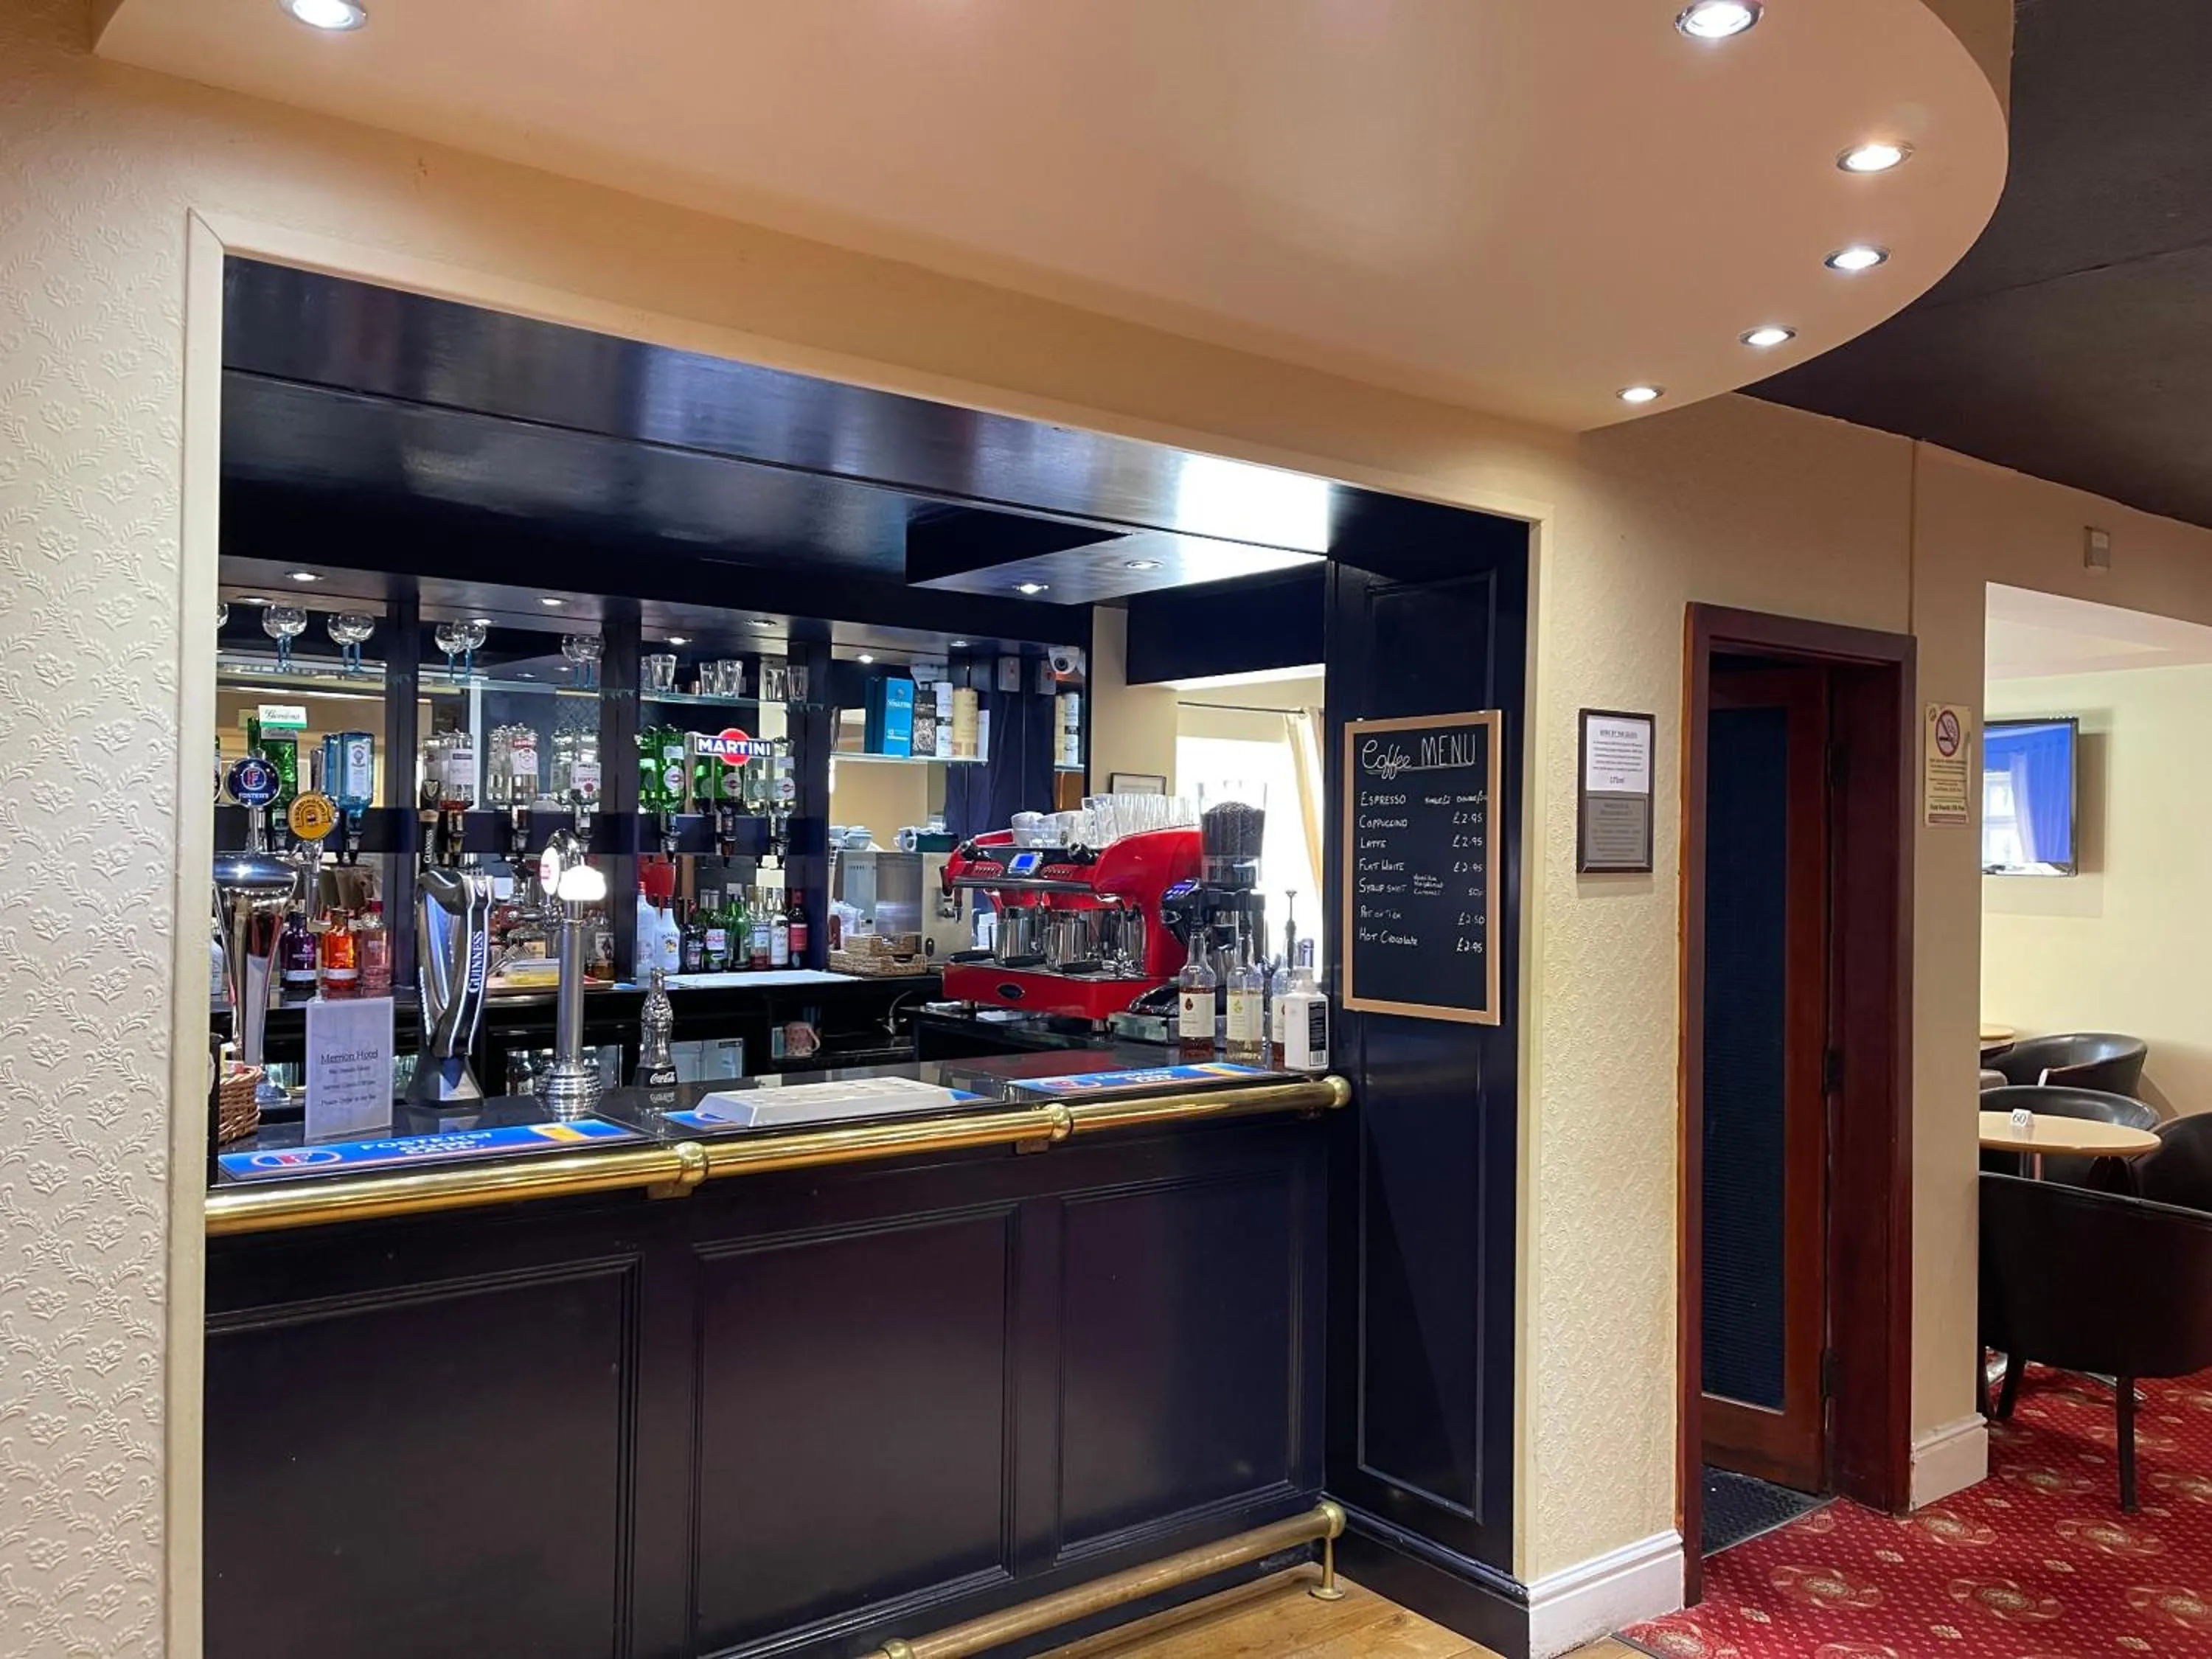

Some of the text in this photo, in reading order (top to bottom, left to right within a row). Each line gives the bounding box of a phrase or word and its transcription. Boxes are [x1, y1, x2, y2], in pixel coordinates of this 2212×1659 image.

[698, 738, 771, 756] MARTINI
[1362, 733, 1475, 780] Coffee MENU
[1360, 791, 1407, 807] ESPRESSO
[1360, 837, 1387, 849] LATTE
[1456, 937, 1484, 953] £2.95
[468, 930, 484, 994] GUINNESS
